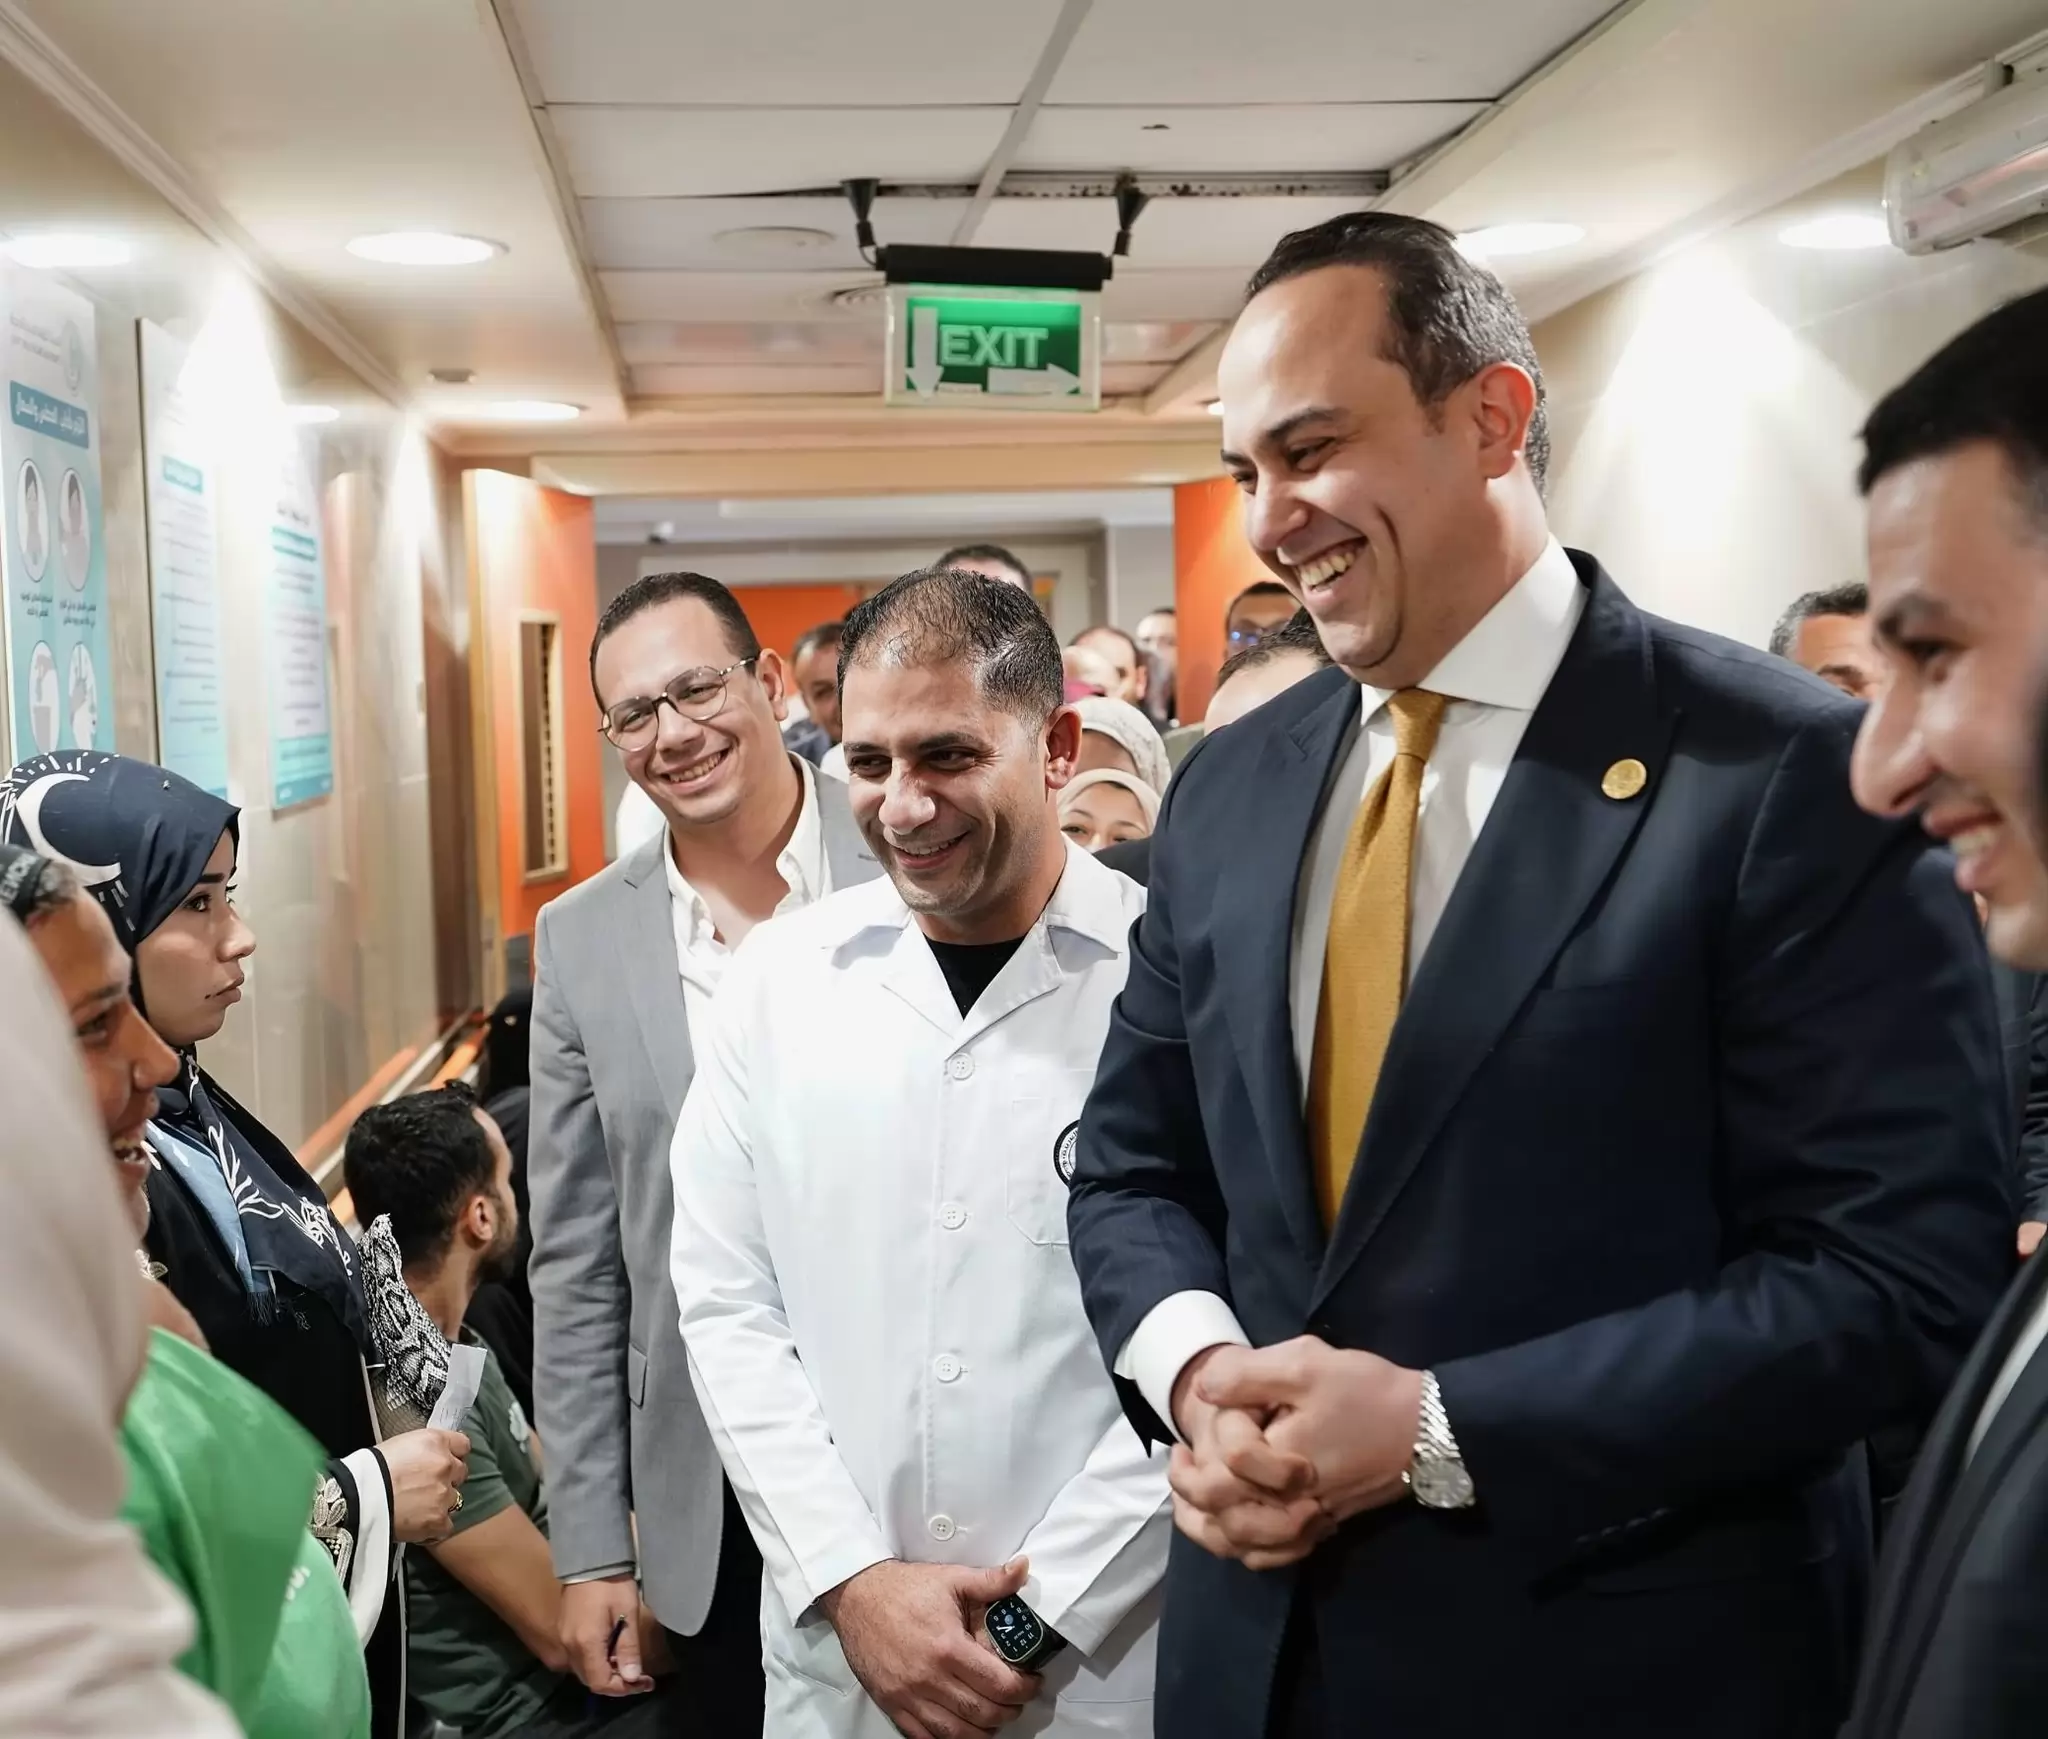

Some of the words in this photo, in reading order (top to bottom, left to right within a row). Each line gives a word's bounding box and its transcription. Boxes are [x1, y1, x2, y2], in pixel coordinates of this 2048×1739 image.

[939, 324, 1049, 368] EXIT
[1024, 1623, 1032, 1631] 10
[1019, 1638, 1027, 1646] 12
